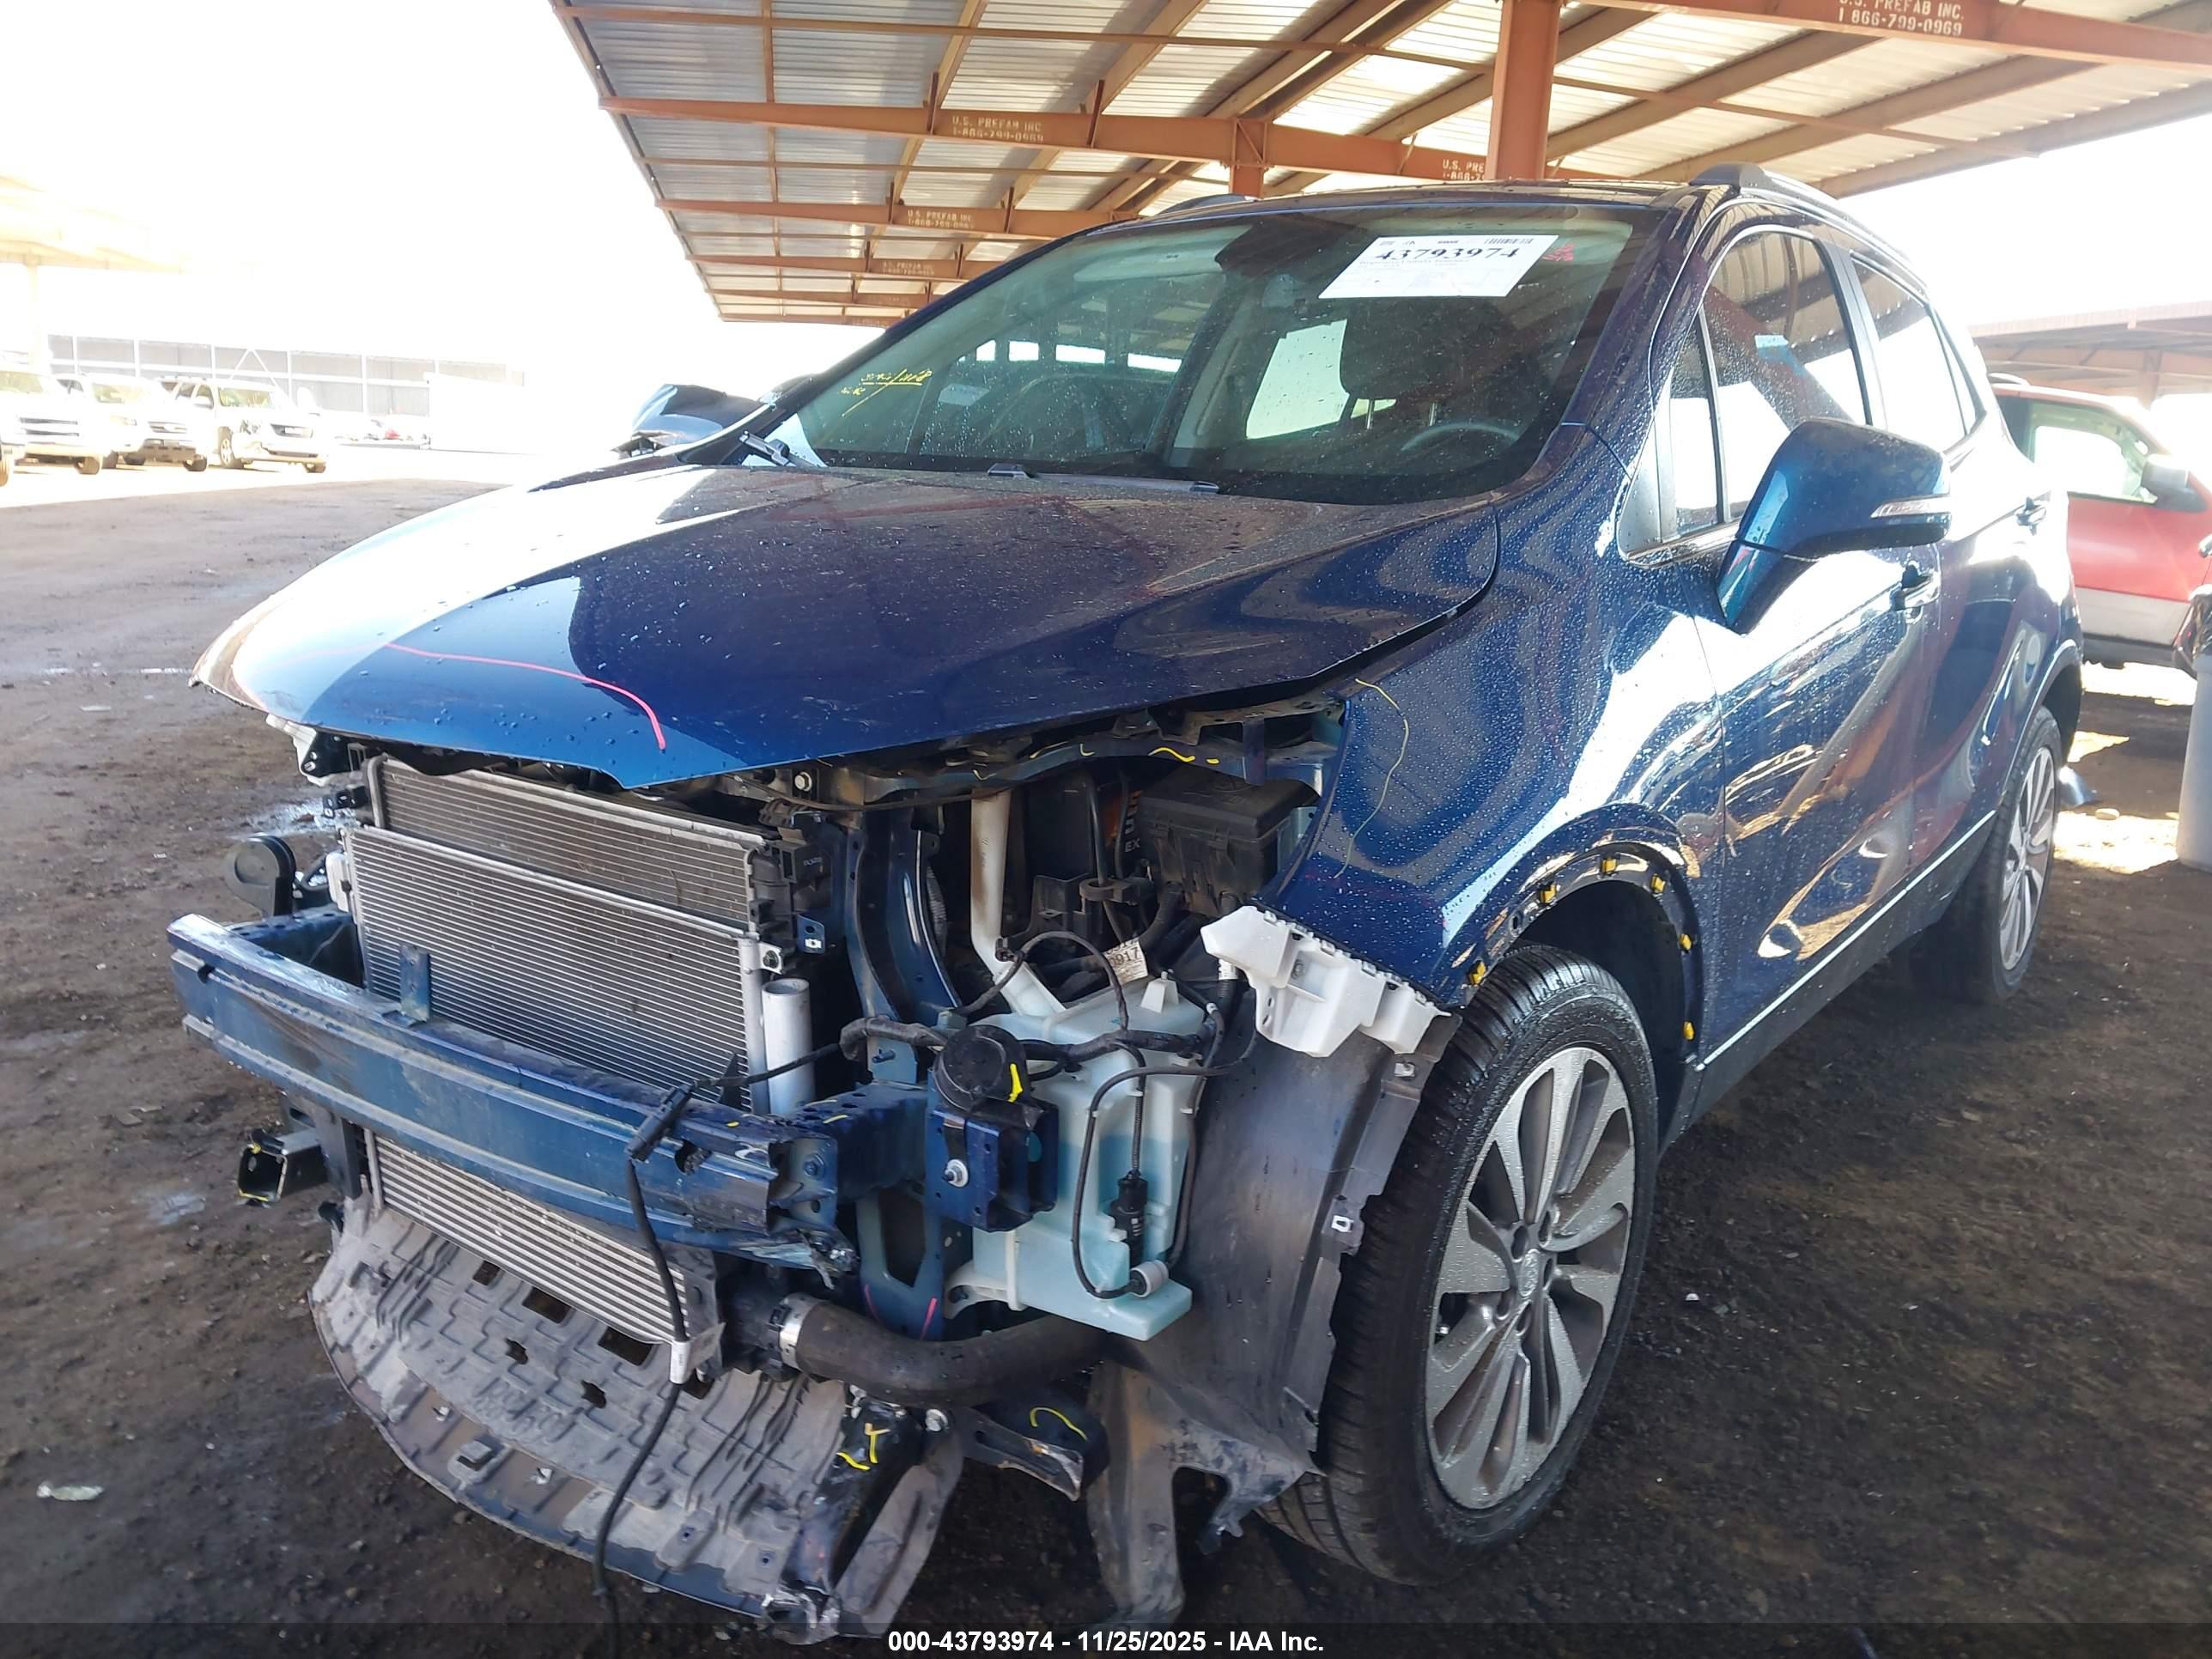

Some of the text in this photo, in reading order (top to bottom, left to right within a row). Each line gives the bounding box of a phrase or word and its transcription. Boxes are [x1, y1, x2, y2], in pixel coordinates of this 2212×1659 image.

[1875, 0, 1931, 15] PREFAB
[1443, 159, 1485, 173] U.S. PRE
[1376, 247, 1521, 261] 43793974
